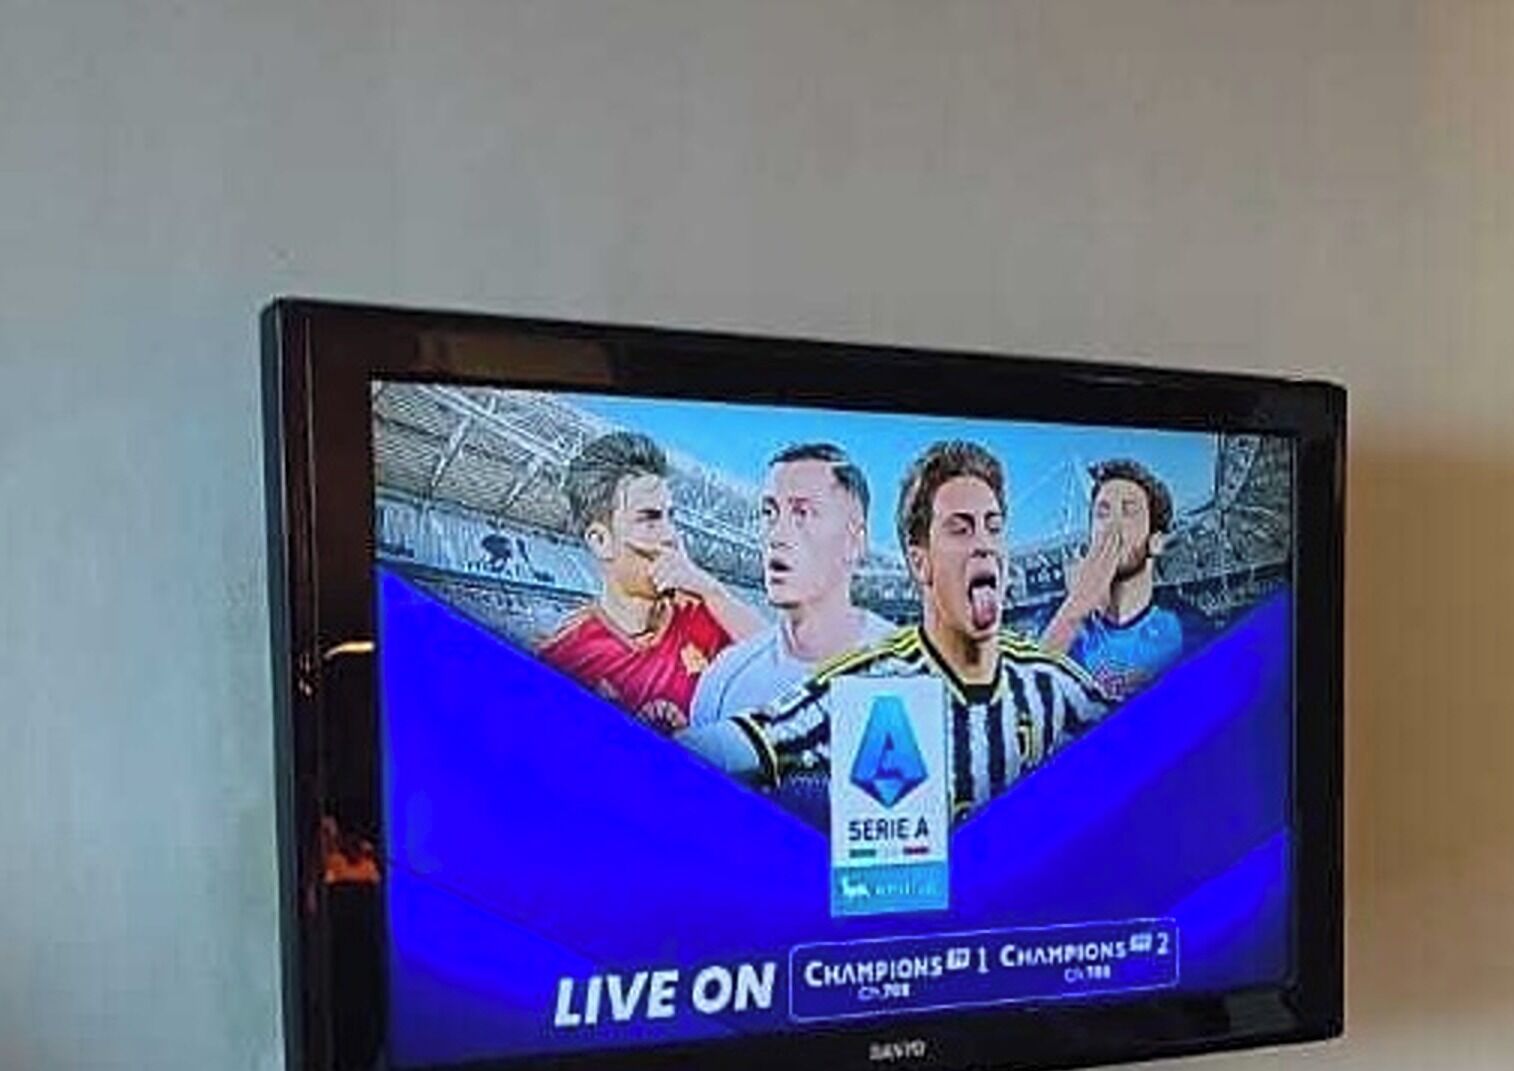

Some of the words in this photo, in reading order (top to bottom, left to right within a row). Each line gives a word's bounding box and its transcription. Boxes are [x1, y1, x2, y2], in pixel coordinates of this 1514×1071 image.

[848, 819, 908, 841] SERIE
[914, 817, 929, 838] A
[804, 955, 943, 988] CHAMPIONS
[976, 946, 990, 974] 1
[1000, 940, 1127, 968] CHAMPIONS
[1156, 931, 1169, 956] 2
[554, 969, 679, 1027] LIVE
[691, 962, 776, 1014] ON
